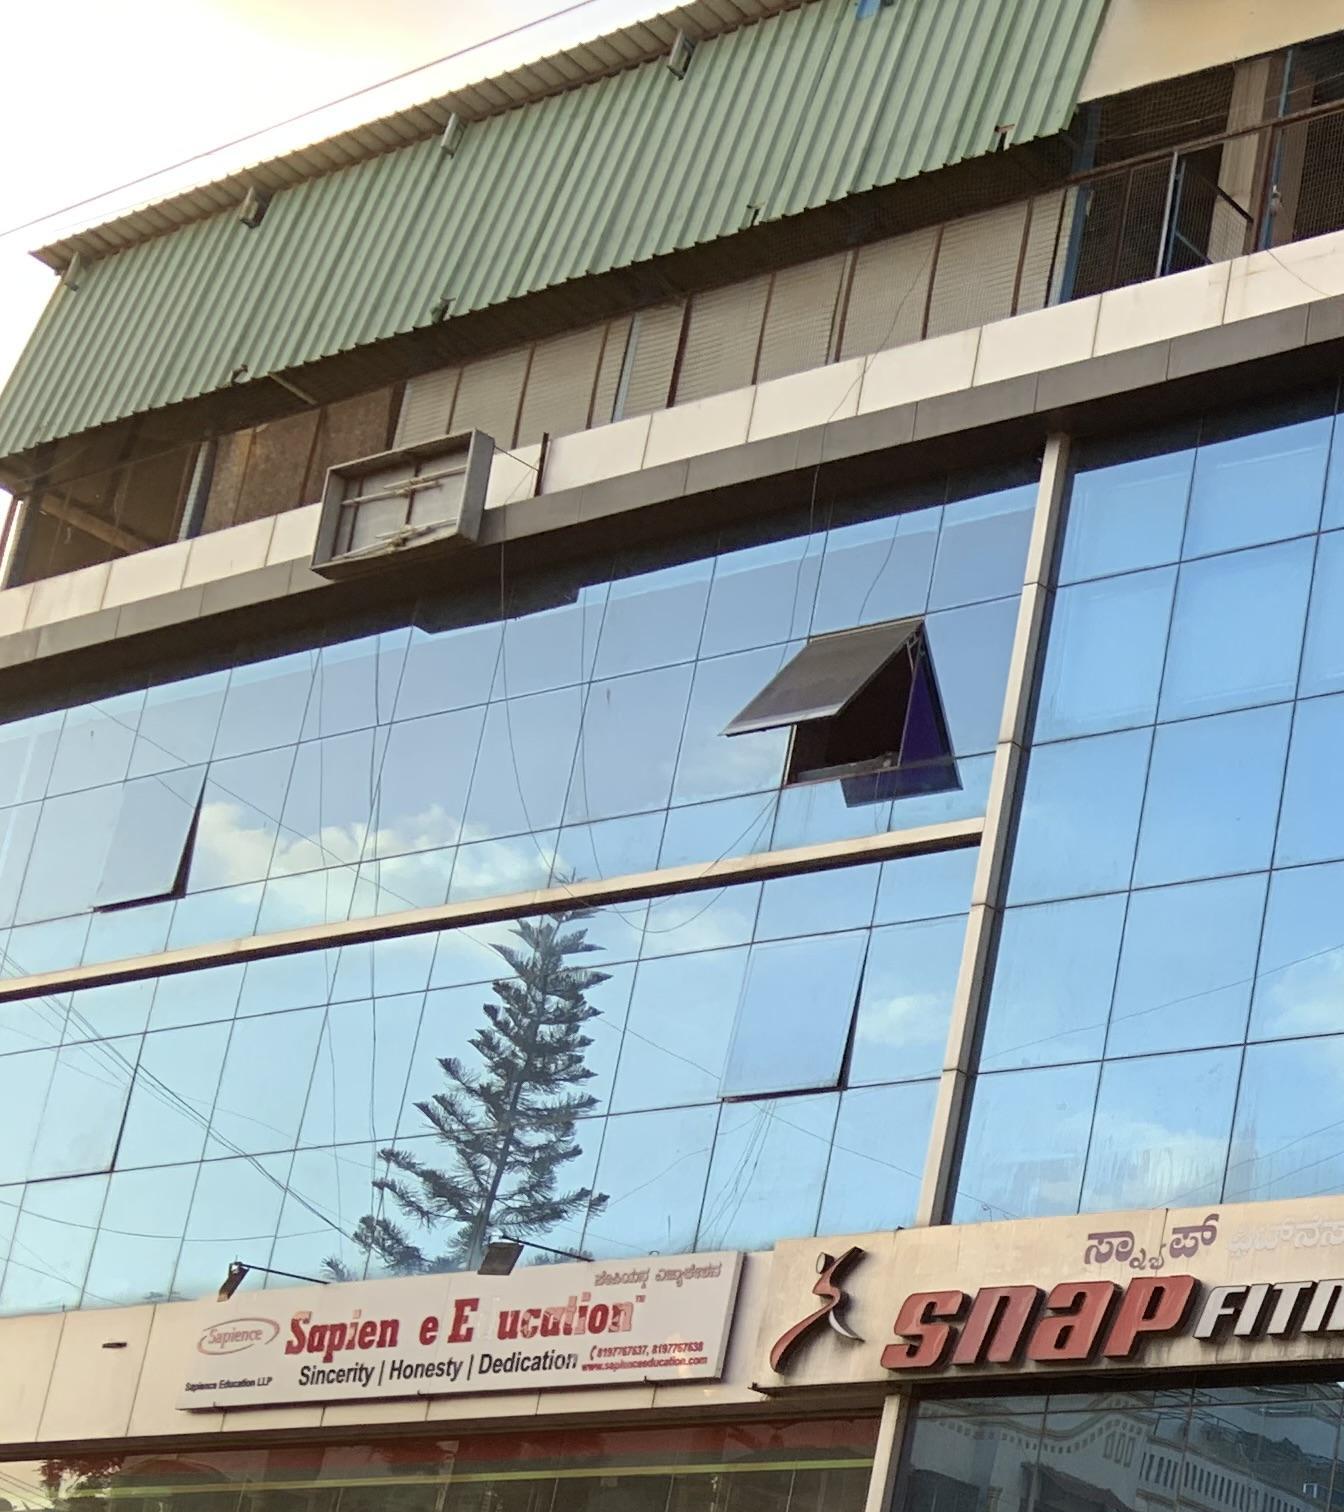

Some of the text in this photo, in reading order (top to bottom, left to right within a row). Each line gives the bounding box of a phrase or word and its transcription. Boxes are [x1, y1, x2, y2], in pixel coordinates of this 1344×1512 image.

[207, 1325, 264, 1348] Sapience
[298, 1361, 377, 1388] Sincerity
[389, 1358, 463, 1381] Honesty
[478, 1350, 579, 1375] Dedication
[257, 1377, 272, 1387] LLP
